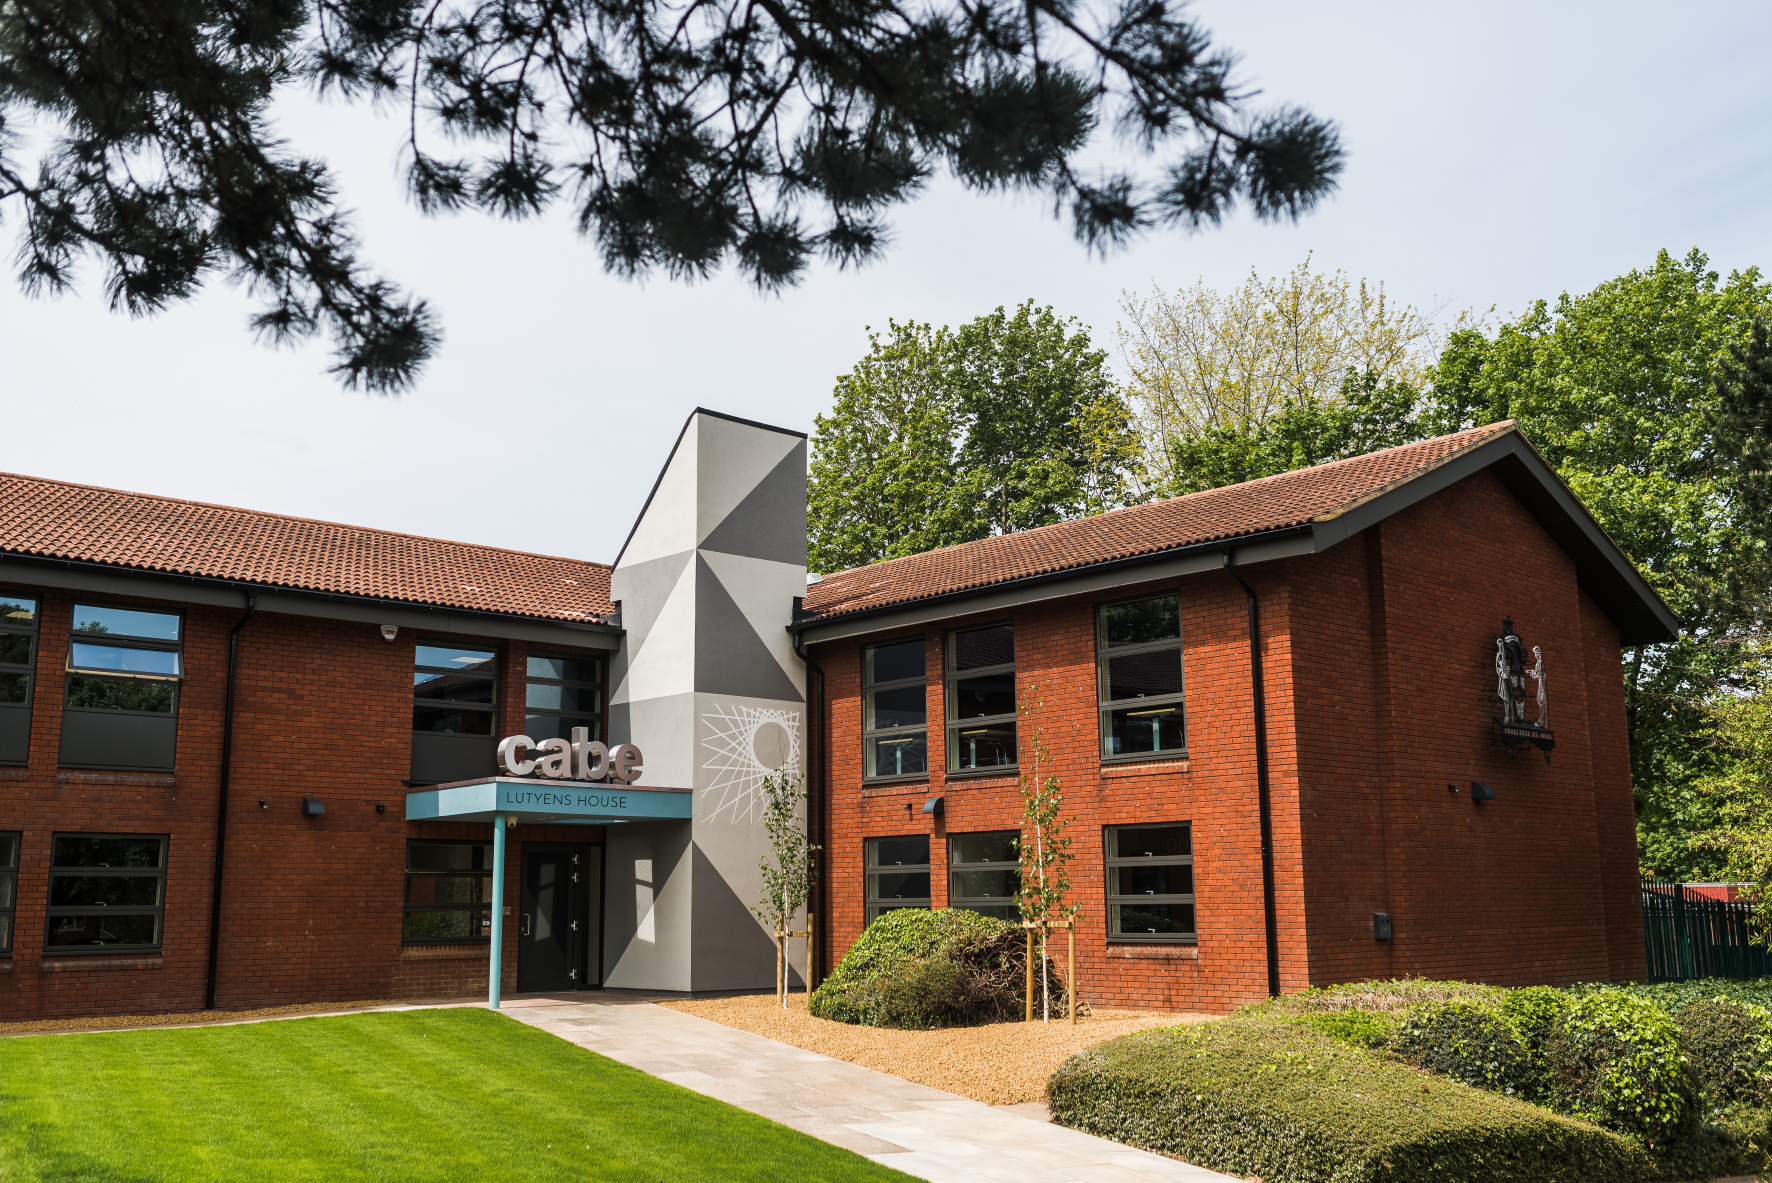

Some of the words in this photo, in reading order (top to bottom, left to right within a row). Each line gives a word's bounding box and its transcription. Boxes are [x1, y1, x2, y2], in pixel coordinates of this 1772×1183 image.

[497, 727, 644, 782] cabe
[506, 792, 572, 806] LUTYENS
[577, 794, 628, 809] HOUSE
